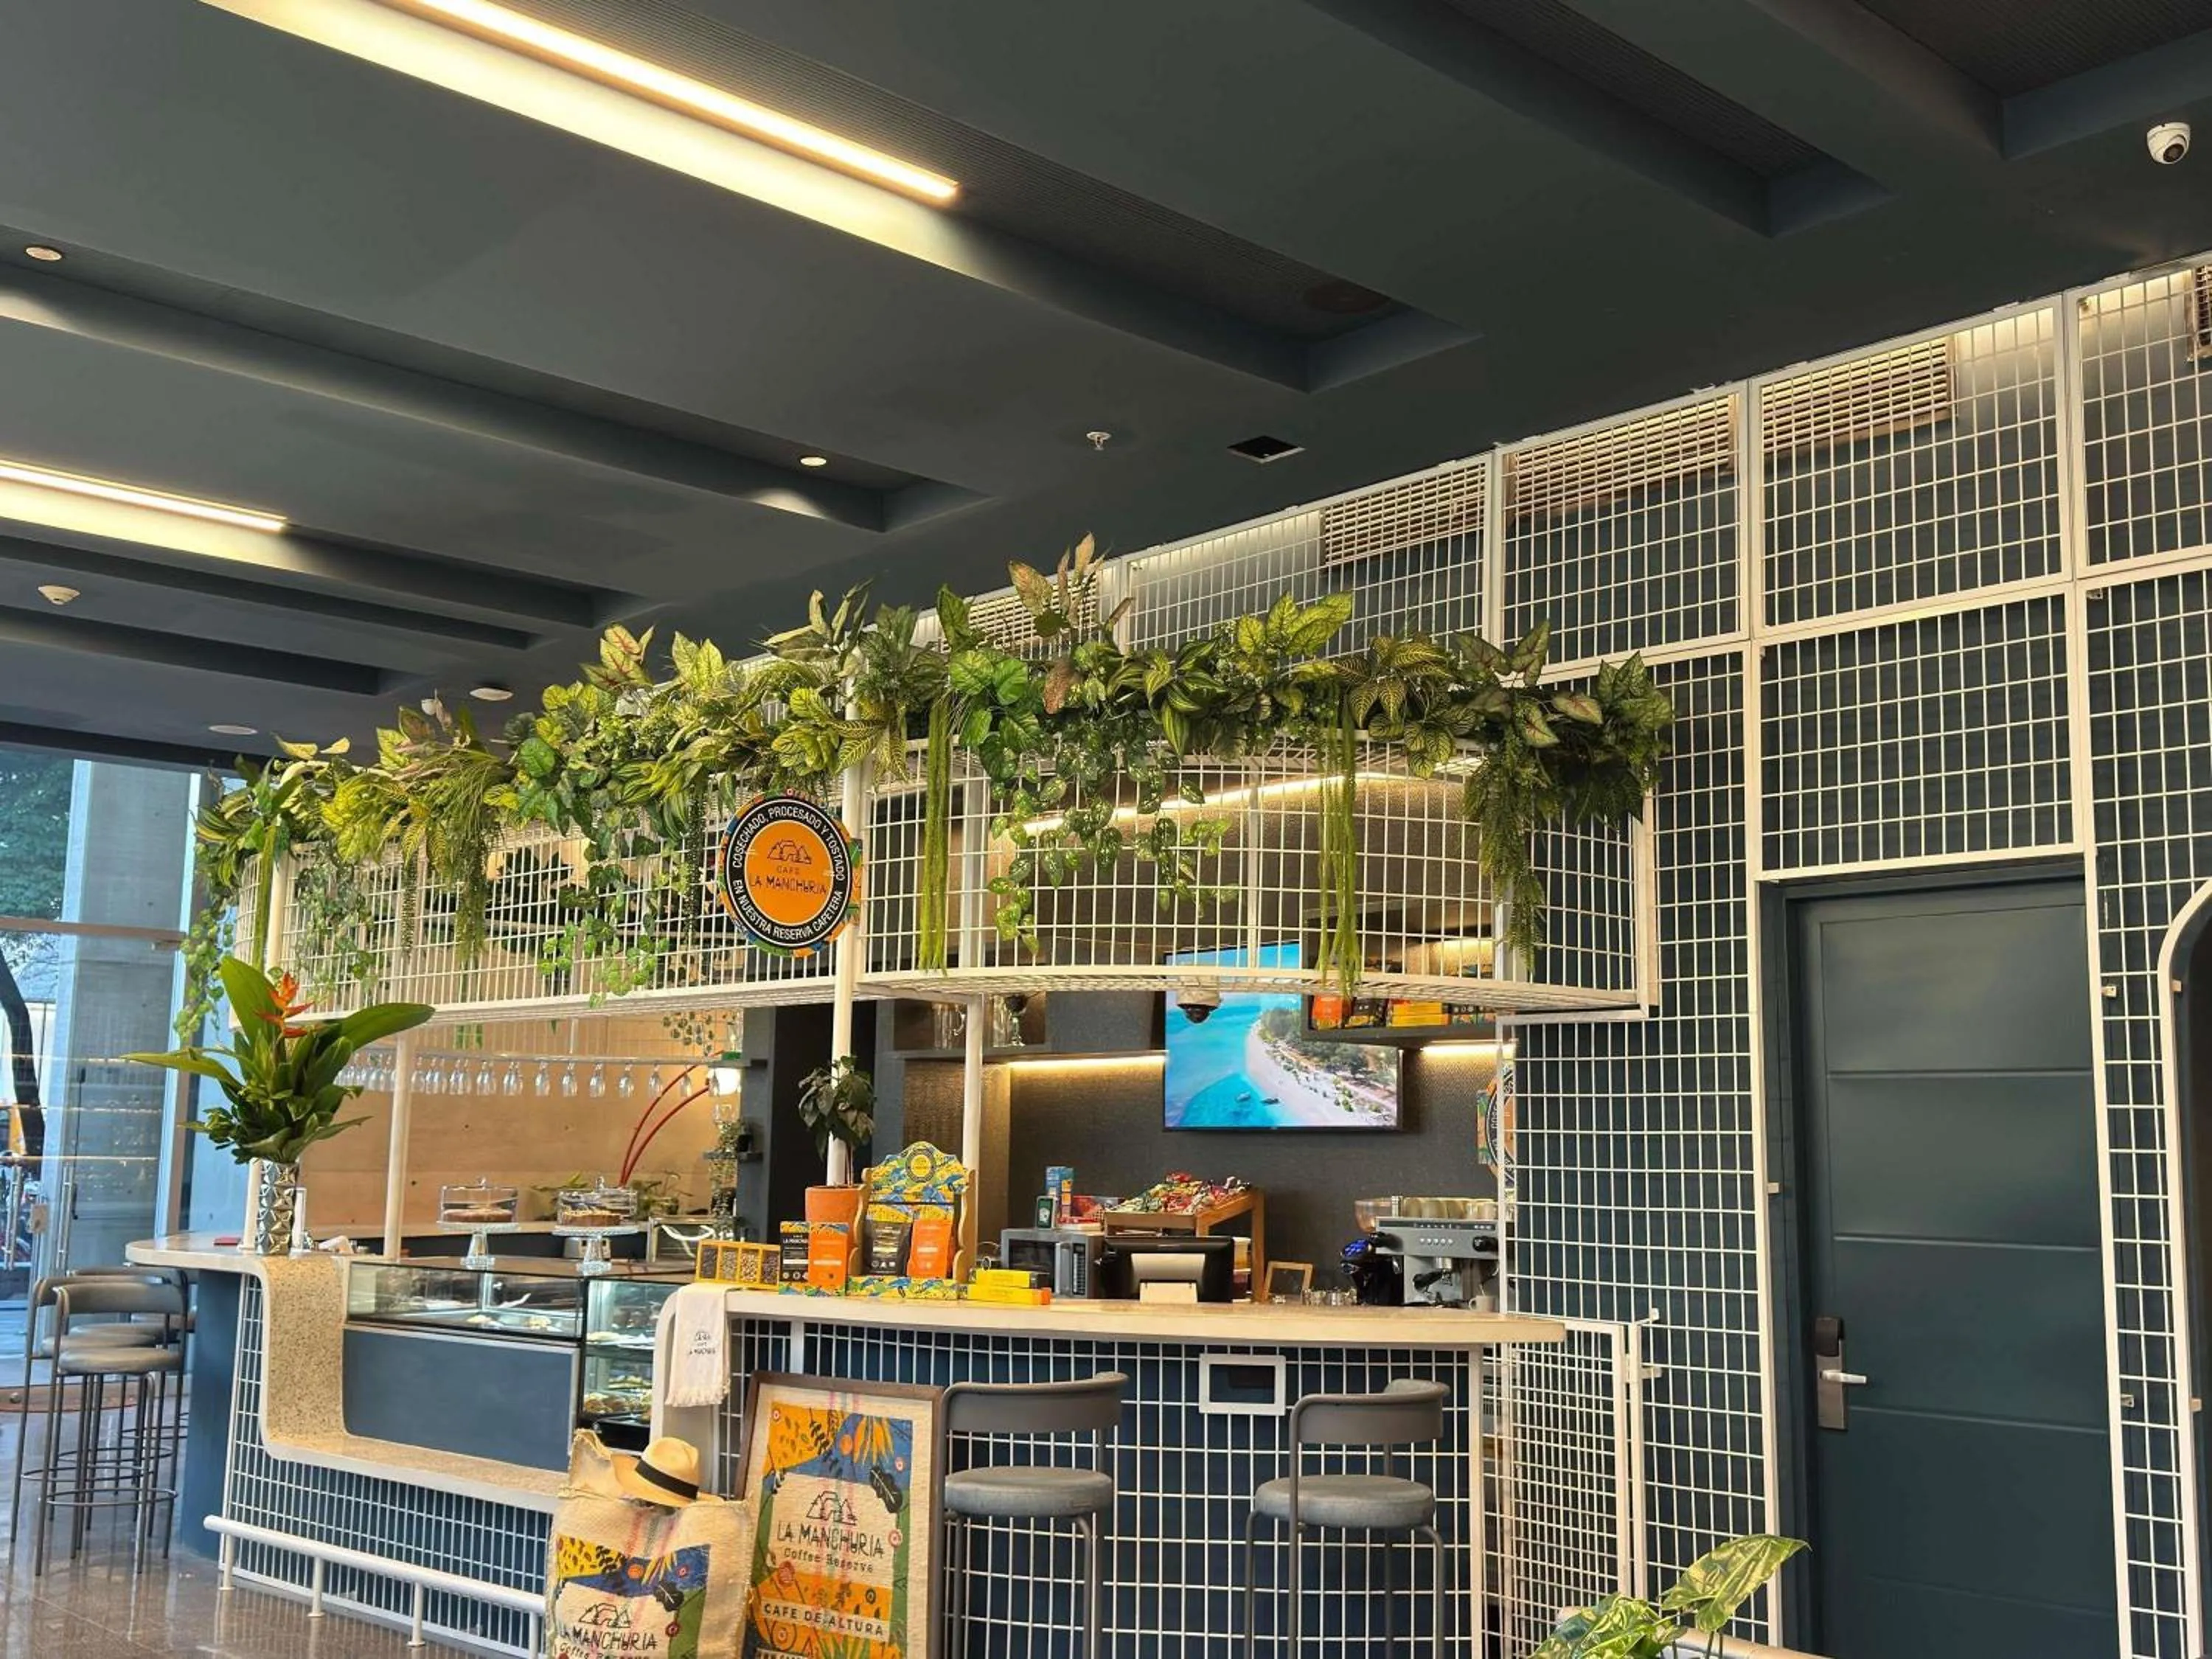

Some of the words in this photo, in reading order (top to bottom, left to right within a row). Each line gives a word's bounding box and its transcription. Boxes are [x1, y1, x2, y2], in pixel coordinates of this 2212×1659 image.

[768, 806, 822, 829] PROCESADO
[821, 825, 830, 835] Y
[826, 833, 846, 881] TOSTADO
[733, 880, 744, 894] EN
[748, 874, 762, 888] LA
[766, 874, 827, 894] MANCHURIA
[738, 894, 772, 934] NUESTRA
[813, 891, 844, 932] CAFETERA
[772, 925, 813, 940] RESERVA
[776, 1520, 793, 1543] LA
[799, 1523, 884, 1559] MANCHURIA
[784, 1548, 821, 1562] Coffee
[764, 1603, 798, 1619] CAFE
[804, 1610, 822, 1623] DE
[829, 1616, 884, 1636] ALTURA
[573, 1625, 658, 1651] MANCHURIA
